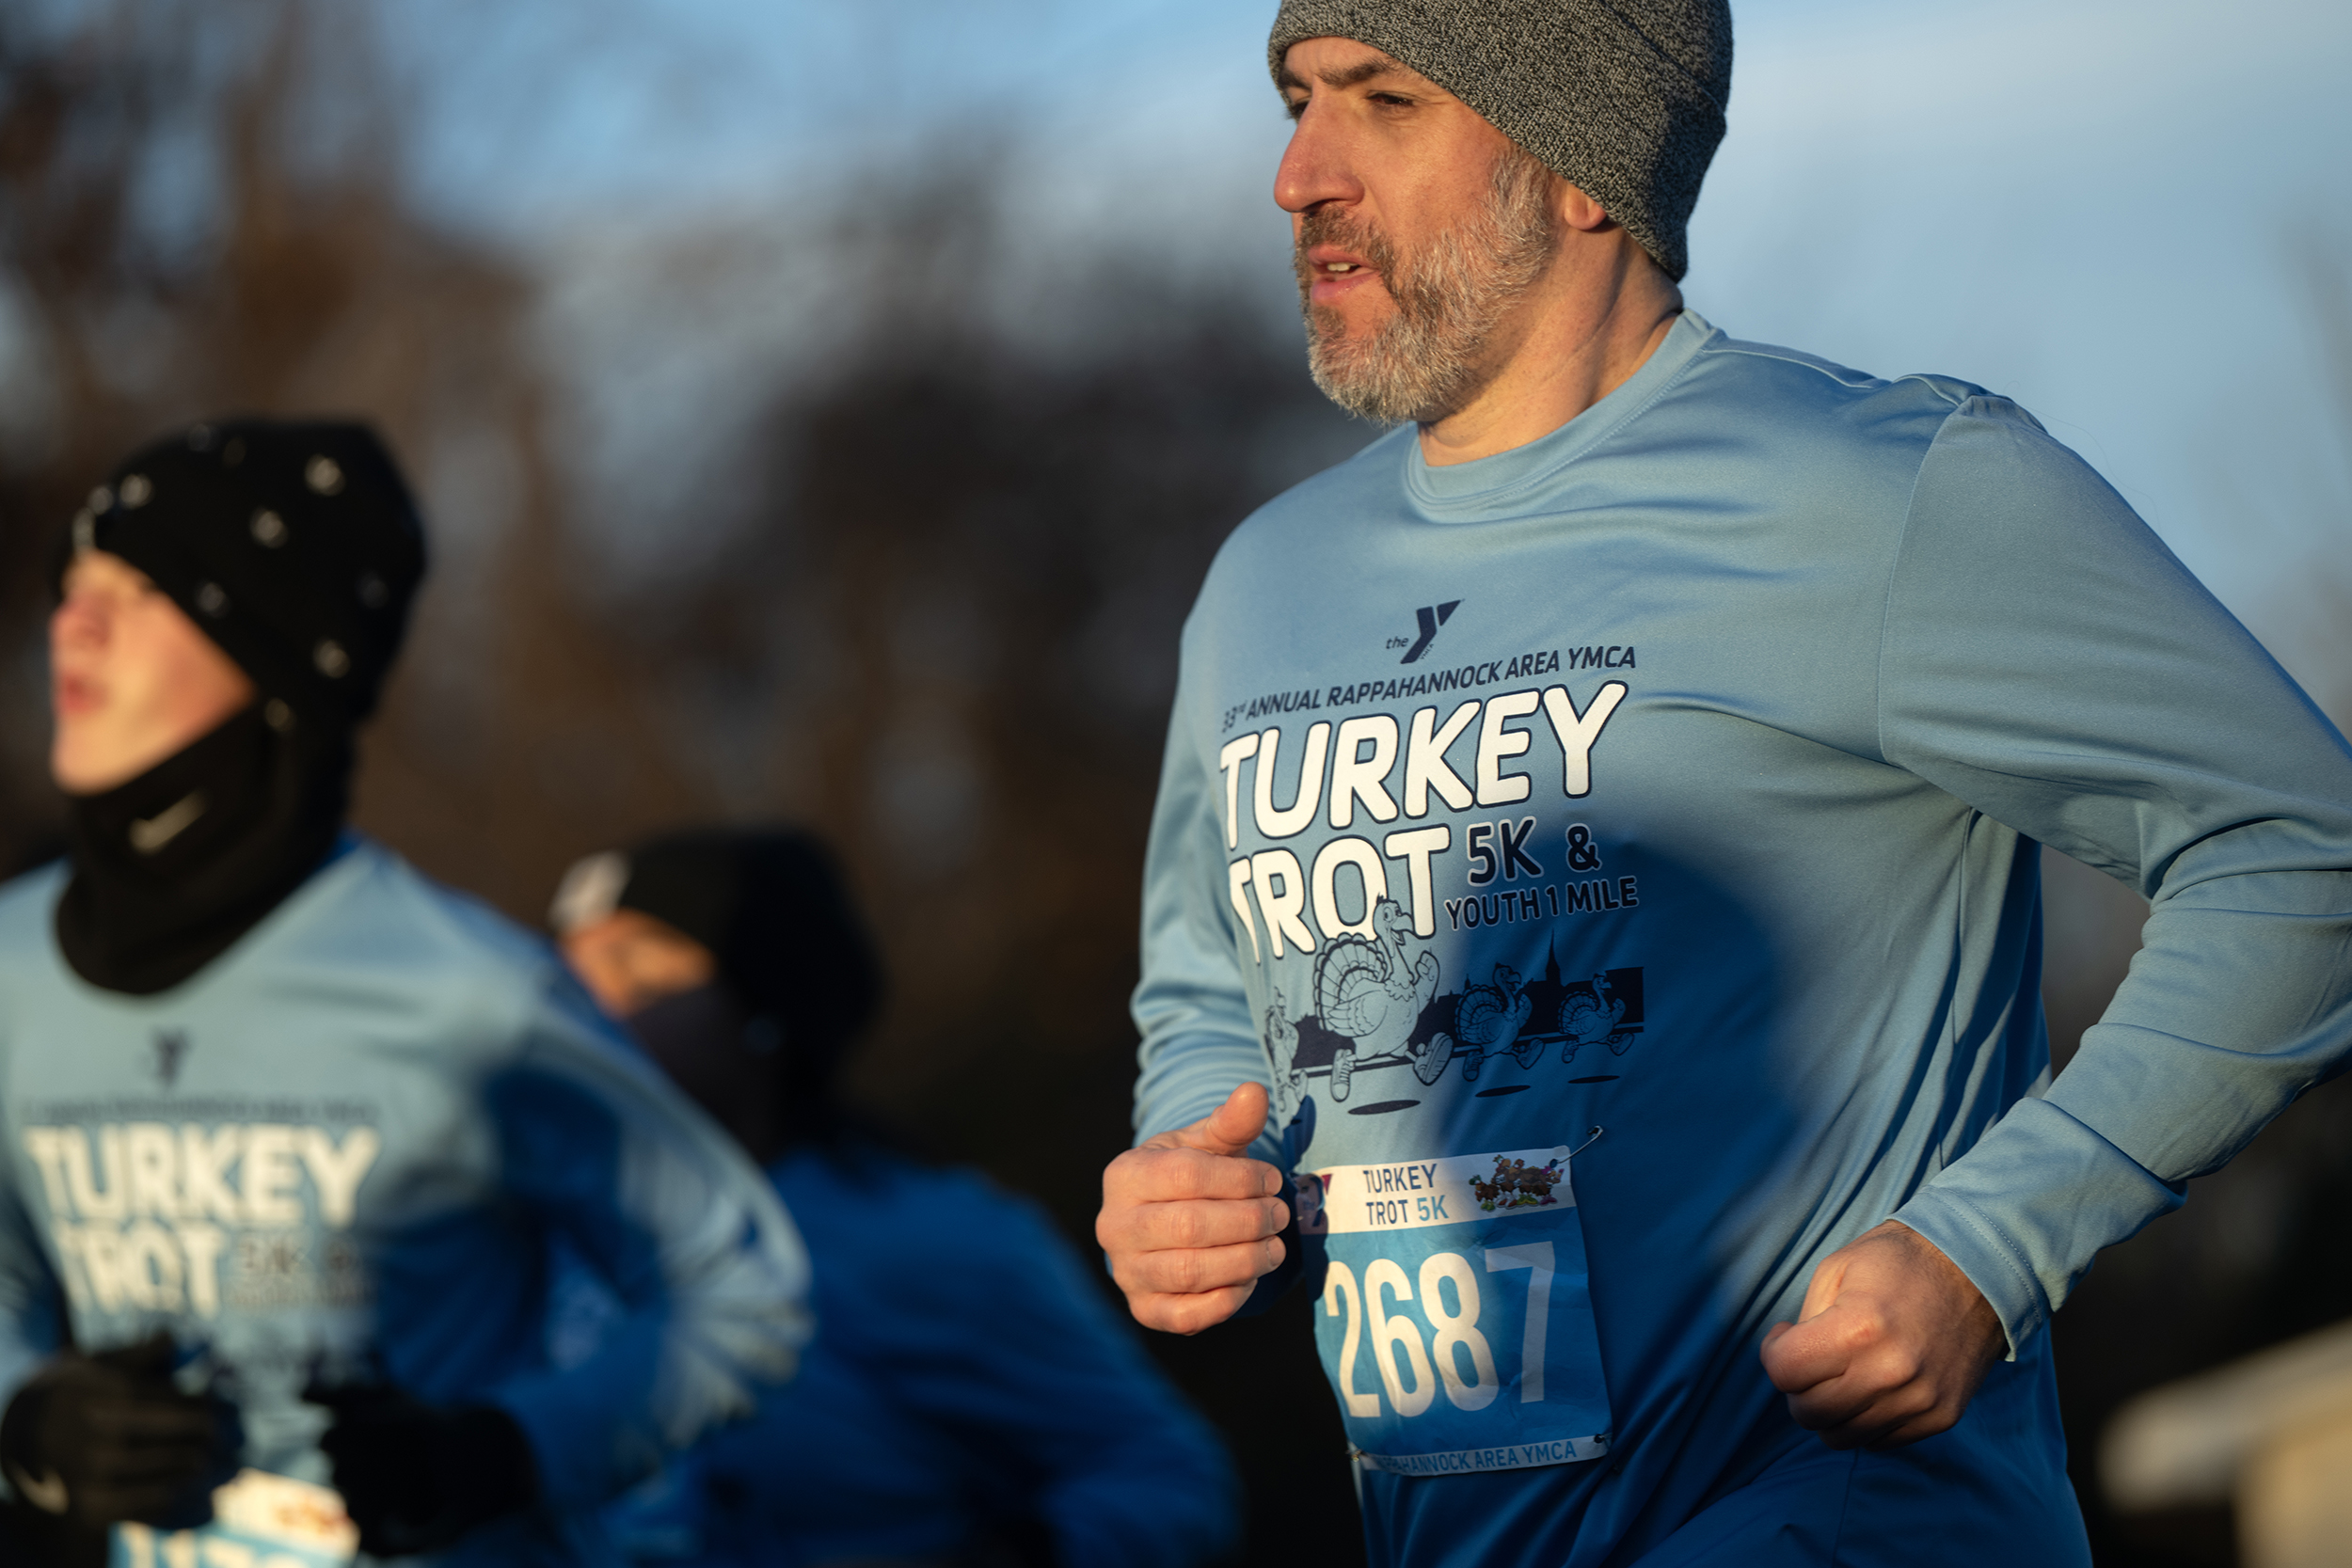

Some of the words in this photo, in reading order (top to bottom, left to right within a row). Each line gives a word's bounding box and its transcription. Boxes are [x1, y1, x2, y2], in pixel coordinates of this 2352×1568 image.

[1386, 636, 1409, 649] the
[1246, 689, 1322, 721] ANNUAL
[1327, 660, 1503, 706] RAPPAHANNOCK
[1504, 650, 1560, 680] AREA
[1568, 645, 1636, 670] YMCA
[1219, 680, 1629, 849] TURKEY
[1229, 824, 1451, 964] TROT
[1466, 816, 1544, 887] 5K
[1565, 822, 1602, 873] &
[1444, 887, 1541, 931] YOUTH
[1545, 885, 1560, 917] 1
[1565, 875, 1639, 915] MILE
[24, 1122, 380, 1227] TURKEY
[1363, 1163, 1437, 1194] TURKEY
[1366, 1199, 1409, 1225] TROT
[1417, 1195, 1449, 1221] 5K
[56, 1223, 222, 1318] TROT
[1324, 1241, 1555, 1418] 2687
[1475, 1448, 1519, 1468] AREA
[1521, 1441, 1577, 1463] YMCA
